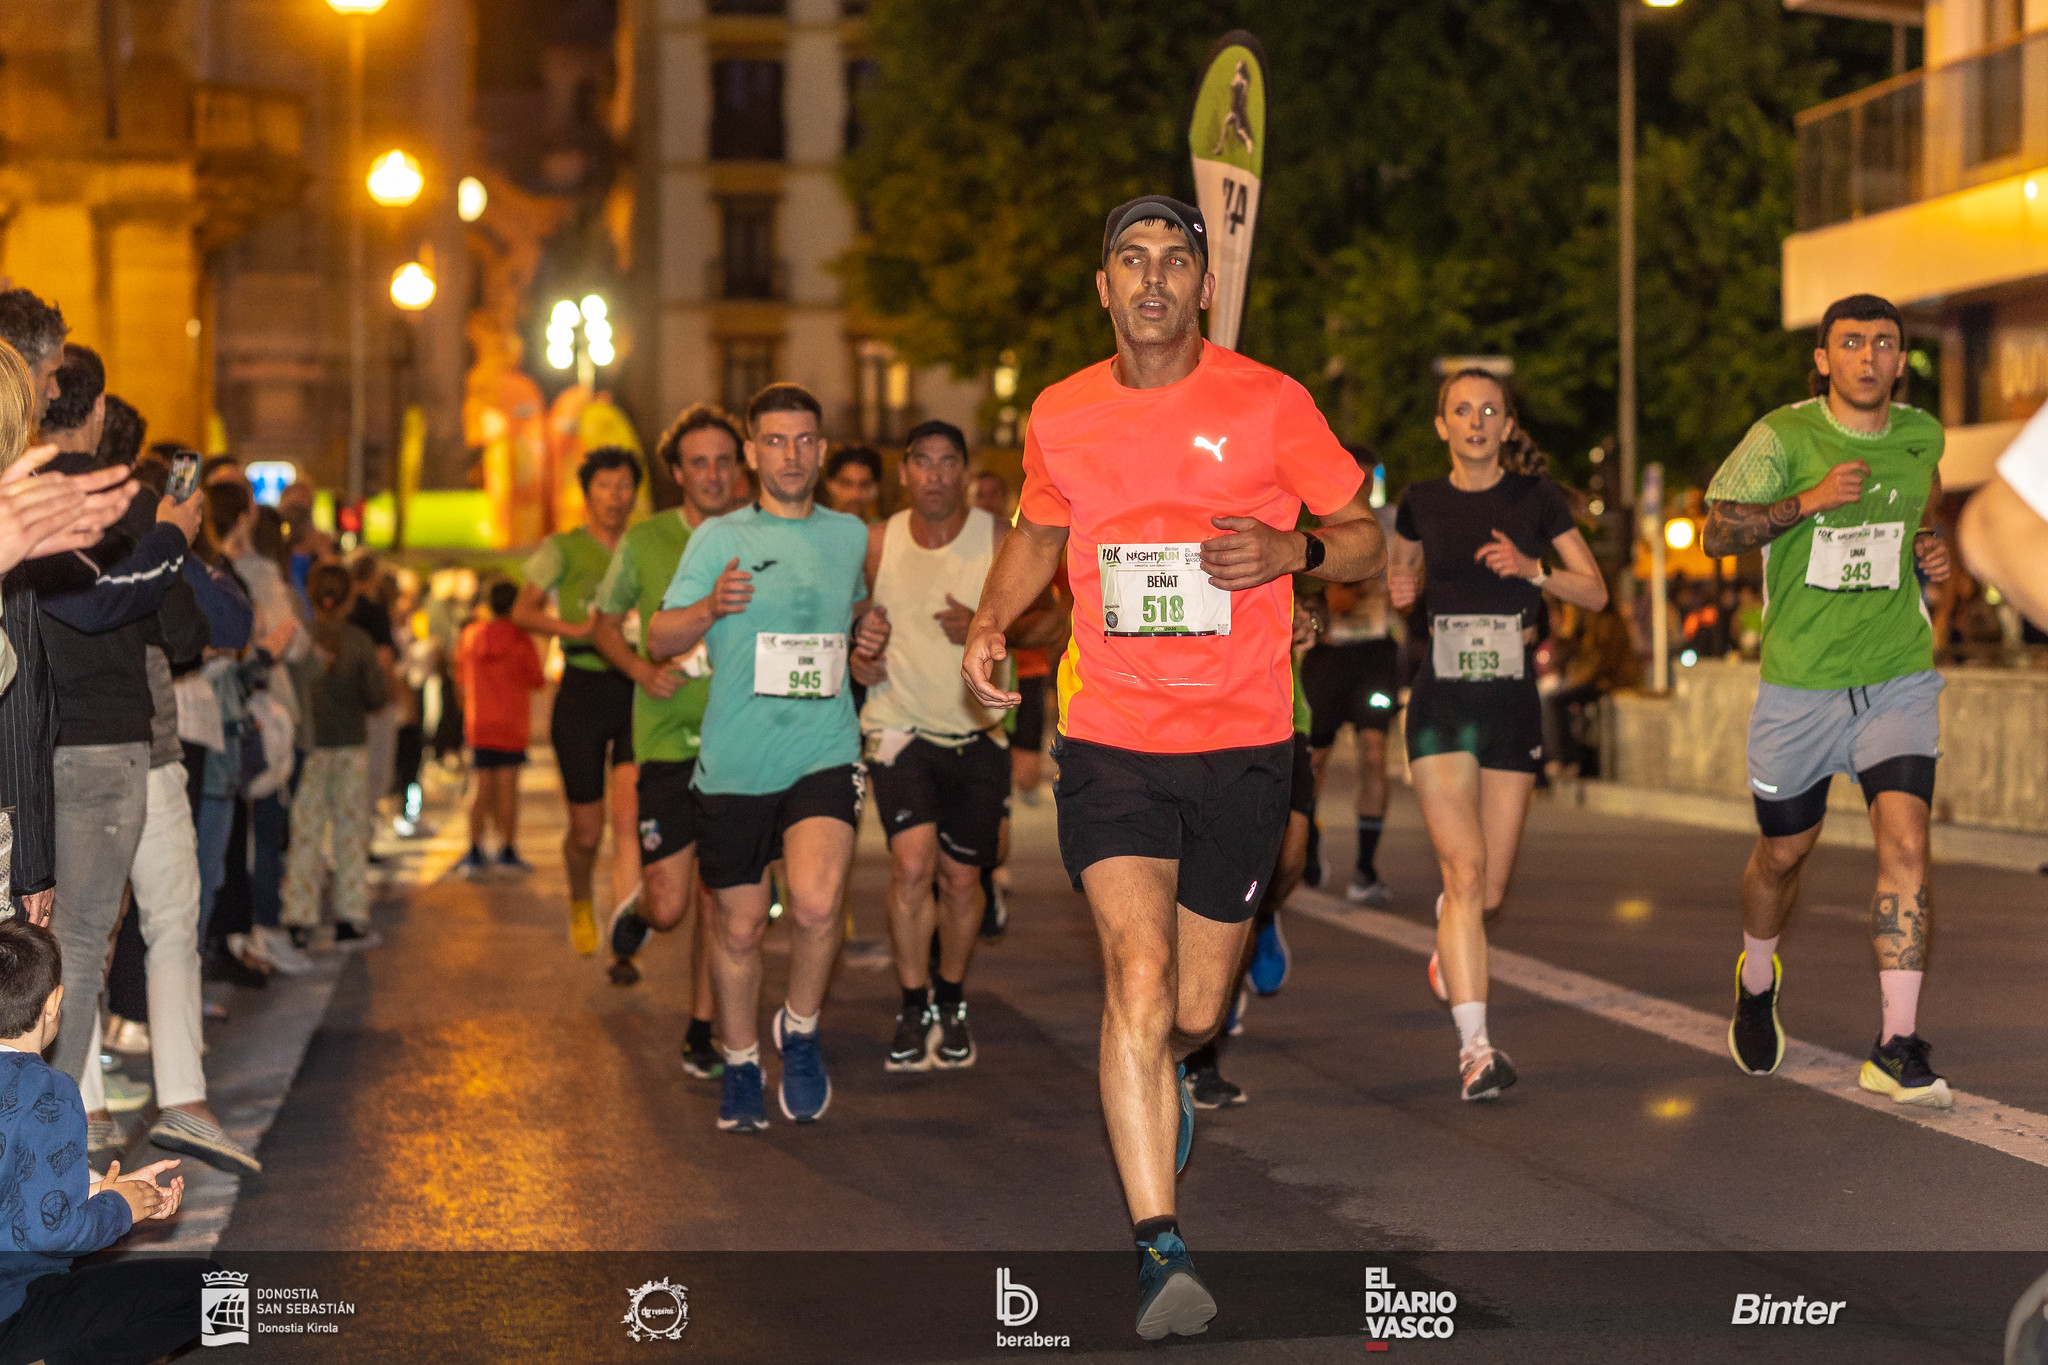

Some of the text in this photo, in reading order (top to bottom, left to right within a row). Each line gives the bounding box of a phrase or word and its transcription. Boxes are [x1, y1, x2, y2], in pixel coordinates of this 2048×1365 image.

[1102, 547, 1121, 564] 10K
[1147, 571, 1178, 588] BEÑAT
[1841, 561, 1871, 582] 343
[1142, 595, 1184, 623] 518
[789, 670, 821, 689] 945
